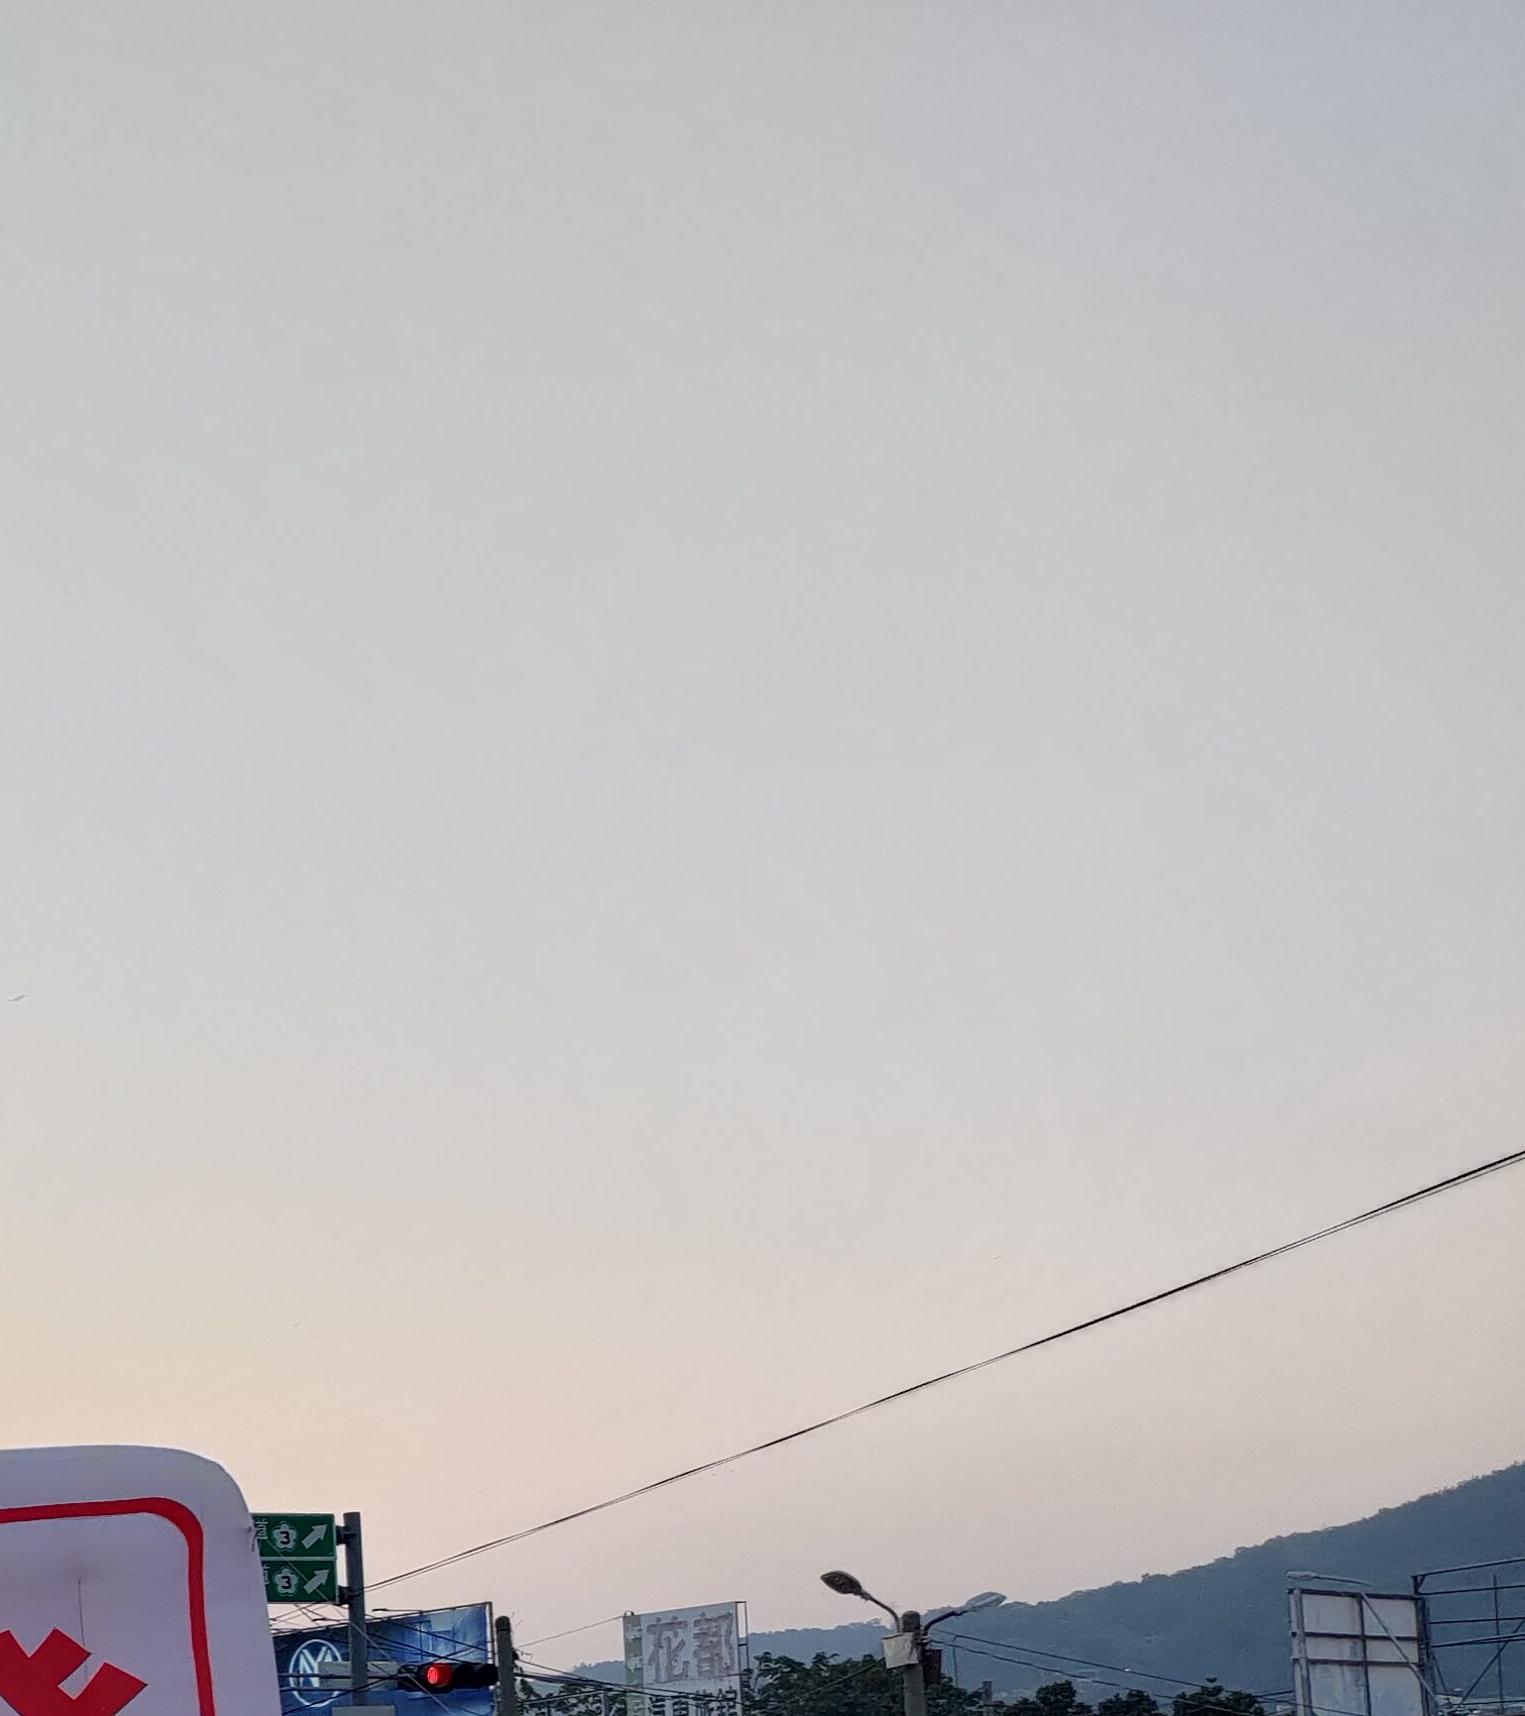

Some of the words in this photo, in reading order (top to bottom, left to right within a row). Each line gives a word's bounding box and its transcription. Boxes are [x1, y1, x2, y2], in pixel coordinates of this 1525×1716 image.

[279, 1531, 291, 1546] 3
[281, 1576, 292, 1590] 3
[646, 1611, 735, 1683] 花都
